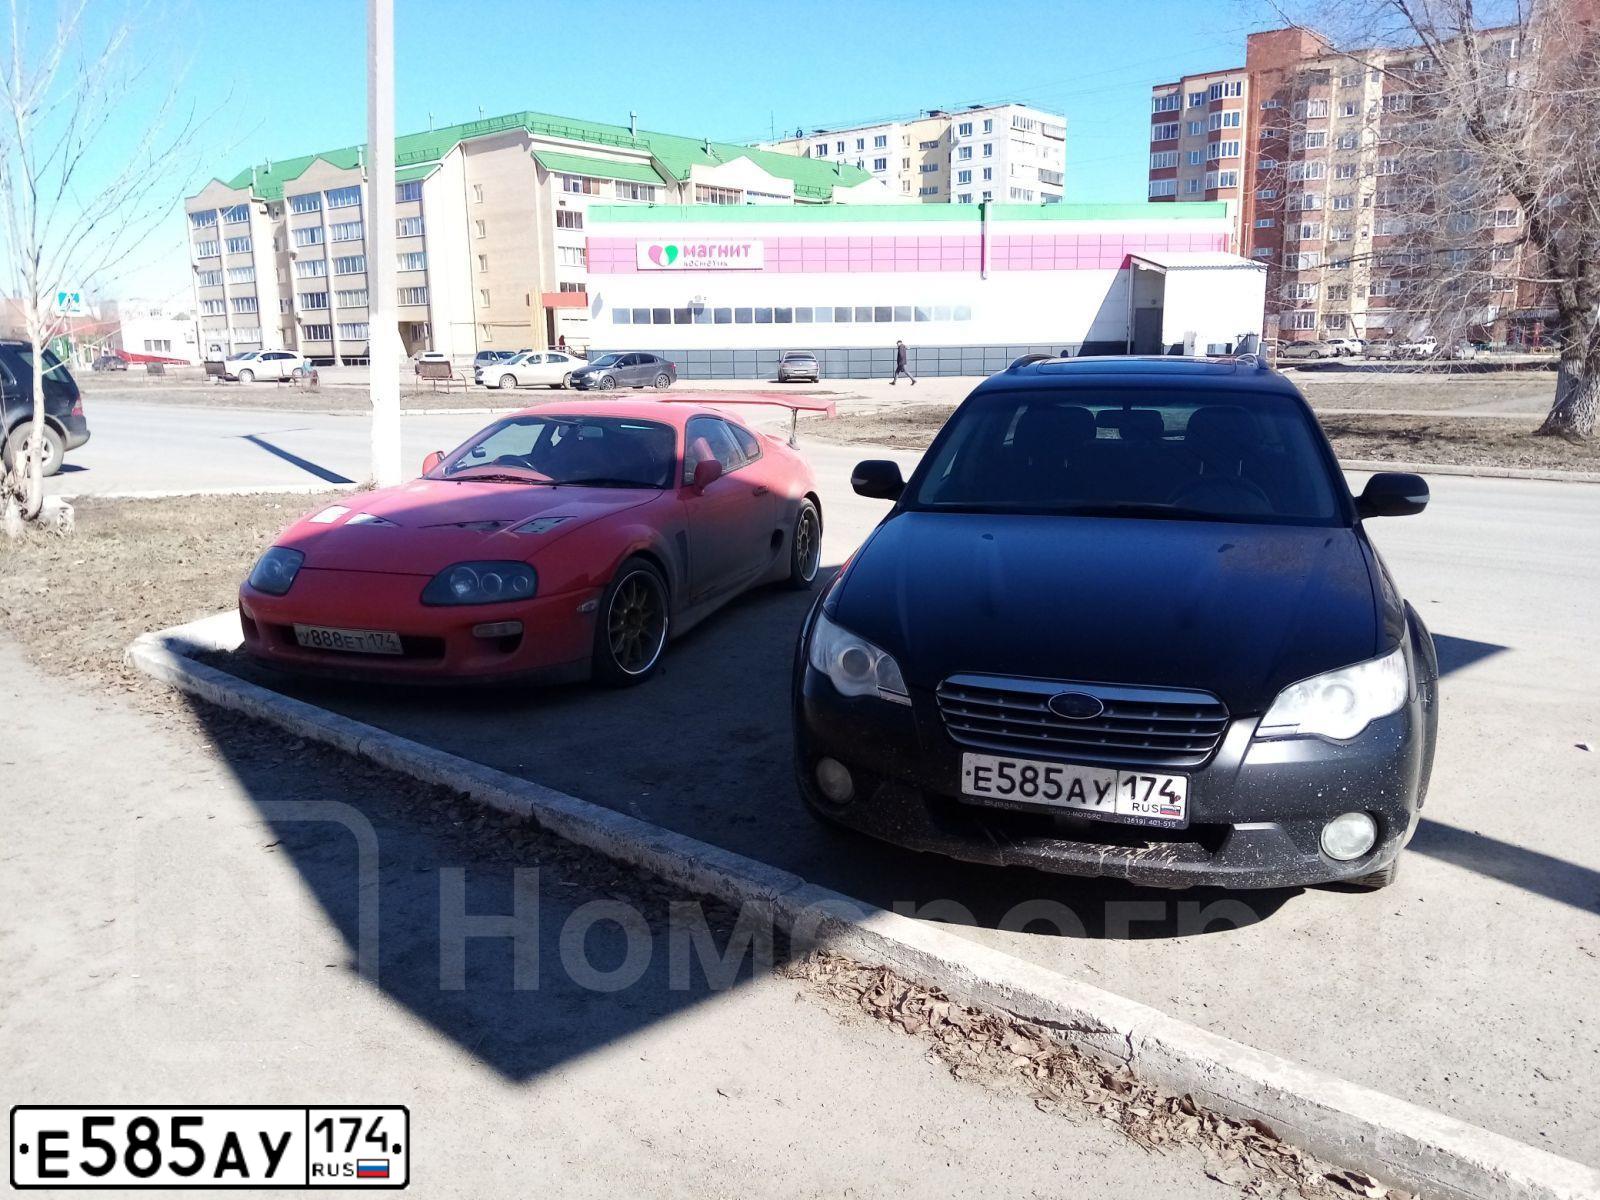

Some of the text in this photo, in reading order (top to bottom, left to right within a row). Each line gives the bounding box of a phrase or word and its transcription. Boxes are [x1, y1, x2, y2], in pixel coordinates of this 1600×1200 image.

[973, 761, 1176, 806] Е585АУ 174
[1132, 802, 1159, 813] RUS
